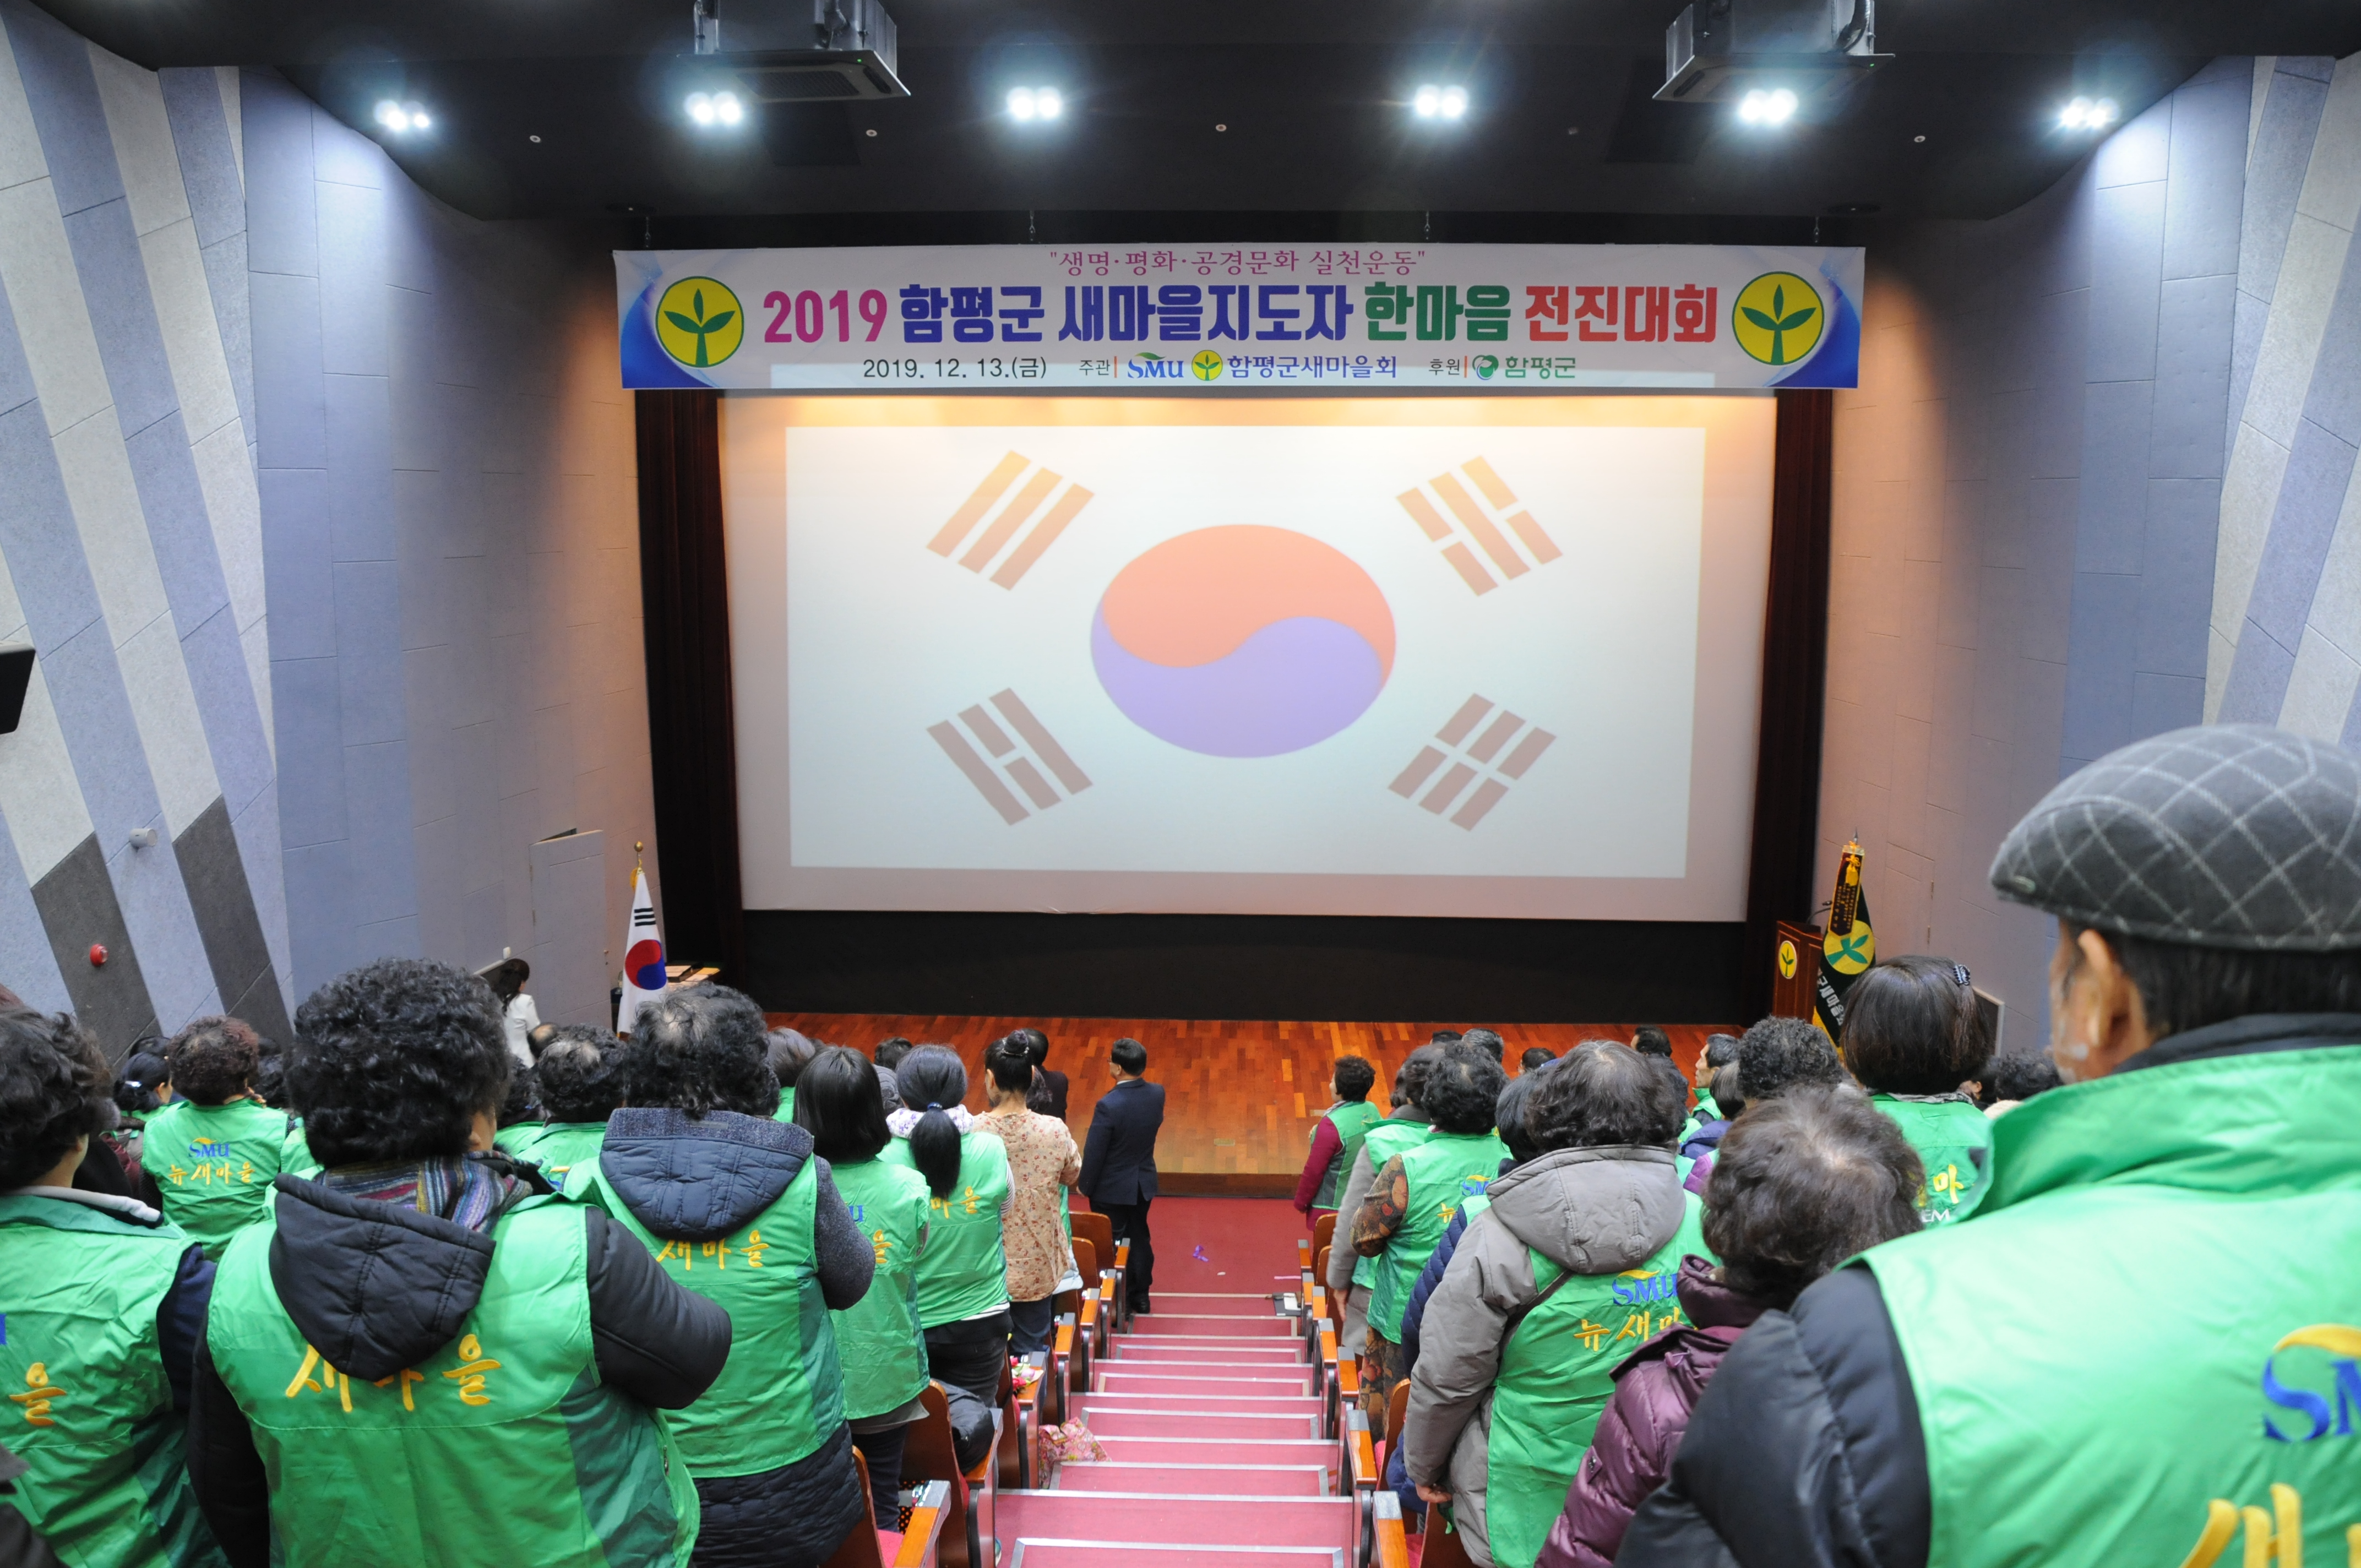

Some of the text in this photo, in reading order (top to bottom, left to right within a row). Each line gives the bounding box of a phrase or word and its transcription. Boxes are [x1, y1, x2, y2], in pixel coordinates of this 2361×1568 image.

[1309, 250, 1425, 276] 실천운동"
[763, 281, 1717, 343] 2019 함평군 새마을지도자 한마음 전진대회
[863, 356, 1047, 379] 2019. 12. 13.(금)
[1079, 352, 1397, 379] 주관 SMU 함평군새마을회
[1429, 356, 1576, 379] 후원 함평군
[188, 1137, 230, 1158] SMU
[1461, 1174, 1490, 1196] SM
[1612, 1270, 1678, 1306] SMU
